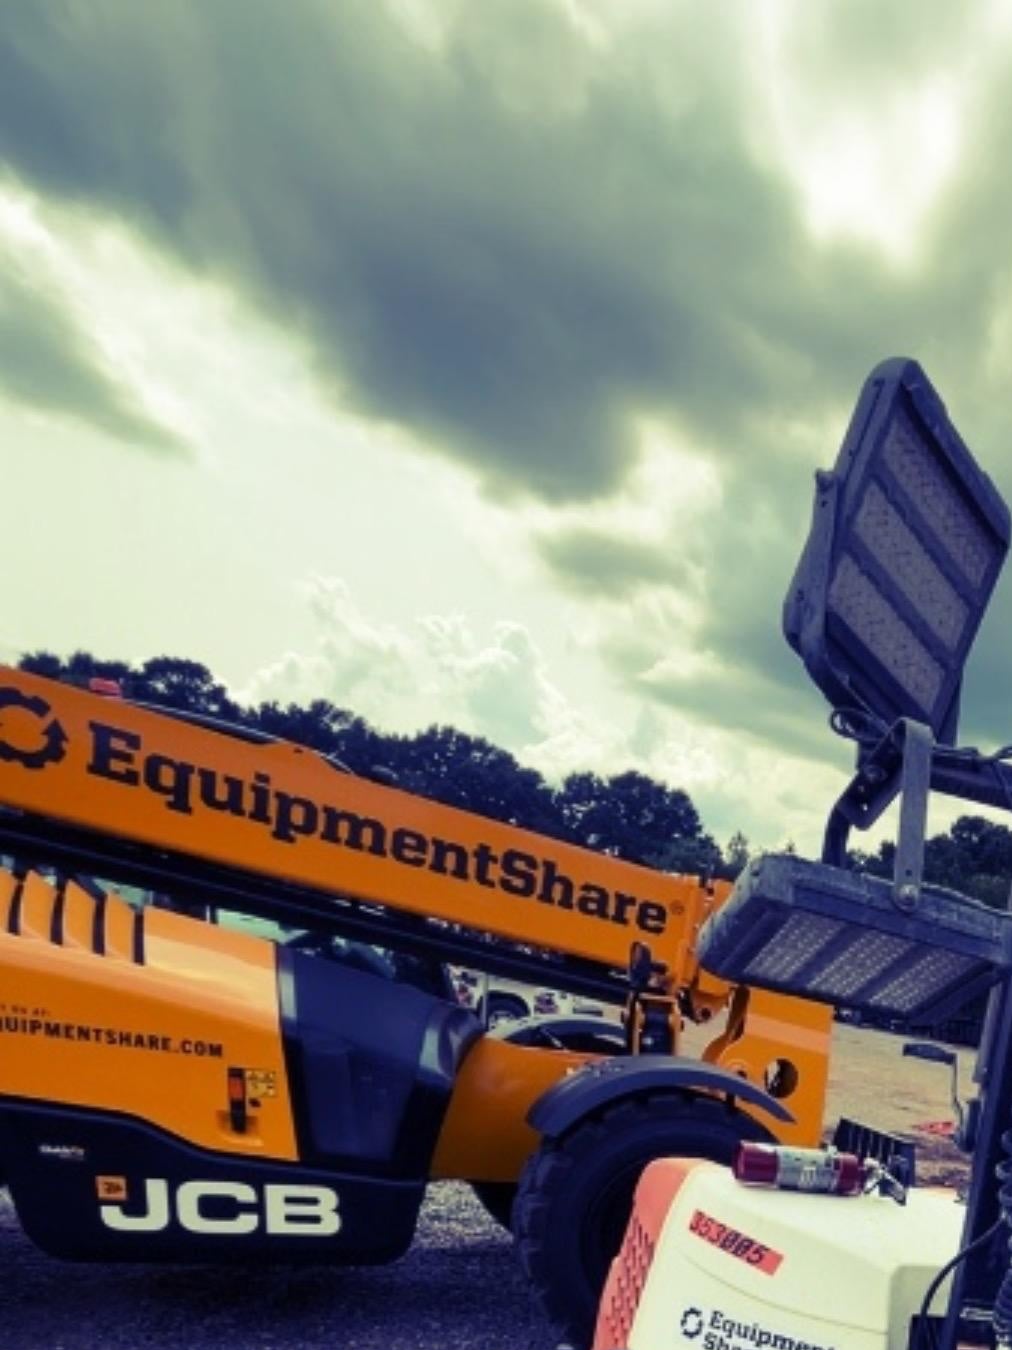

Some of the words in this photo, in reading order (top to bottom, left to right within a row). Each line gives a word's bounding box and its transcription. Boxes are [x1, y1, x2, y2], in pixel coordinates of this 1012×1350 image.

[87, 721, 668, 935] EquipmentShare
[0, 1015, 223, 1058] UIPMENTSHARE.COM
[100, 1178, 342, 1236] JCB
